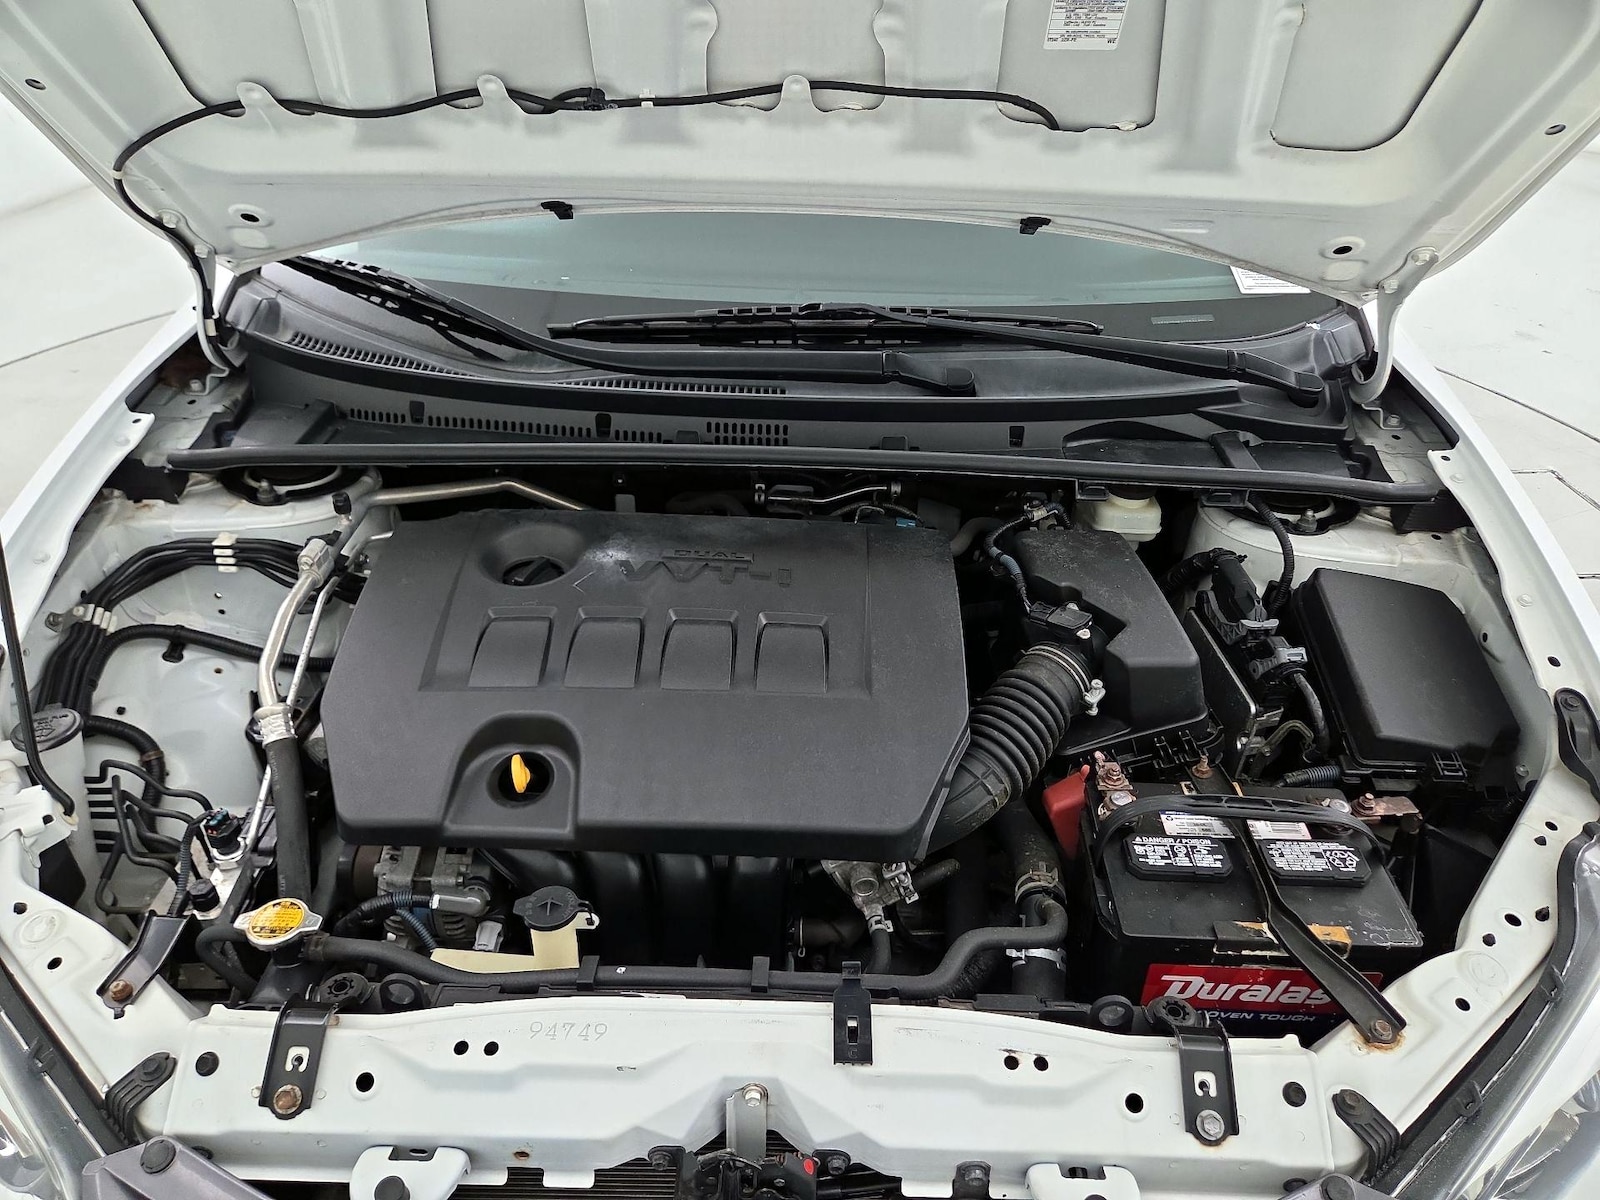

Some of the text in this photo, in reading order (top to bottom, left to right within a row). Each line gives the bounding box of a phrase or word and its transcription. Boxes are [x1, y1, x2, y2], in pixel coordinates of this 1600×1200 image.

[674, 549, 745, 559] DUAL
[1160, 975, 1332, 1005] Duralas
[1206, 1010, 1316, 1023] OVEN TOUGH
[528, 1021, 608, 1041] 94749
